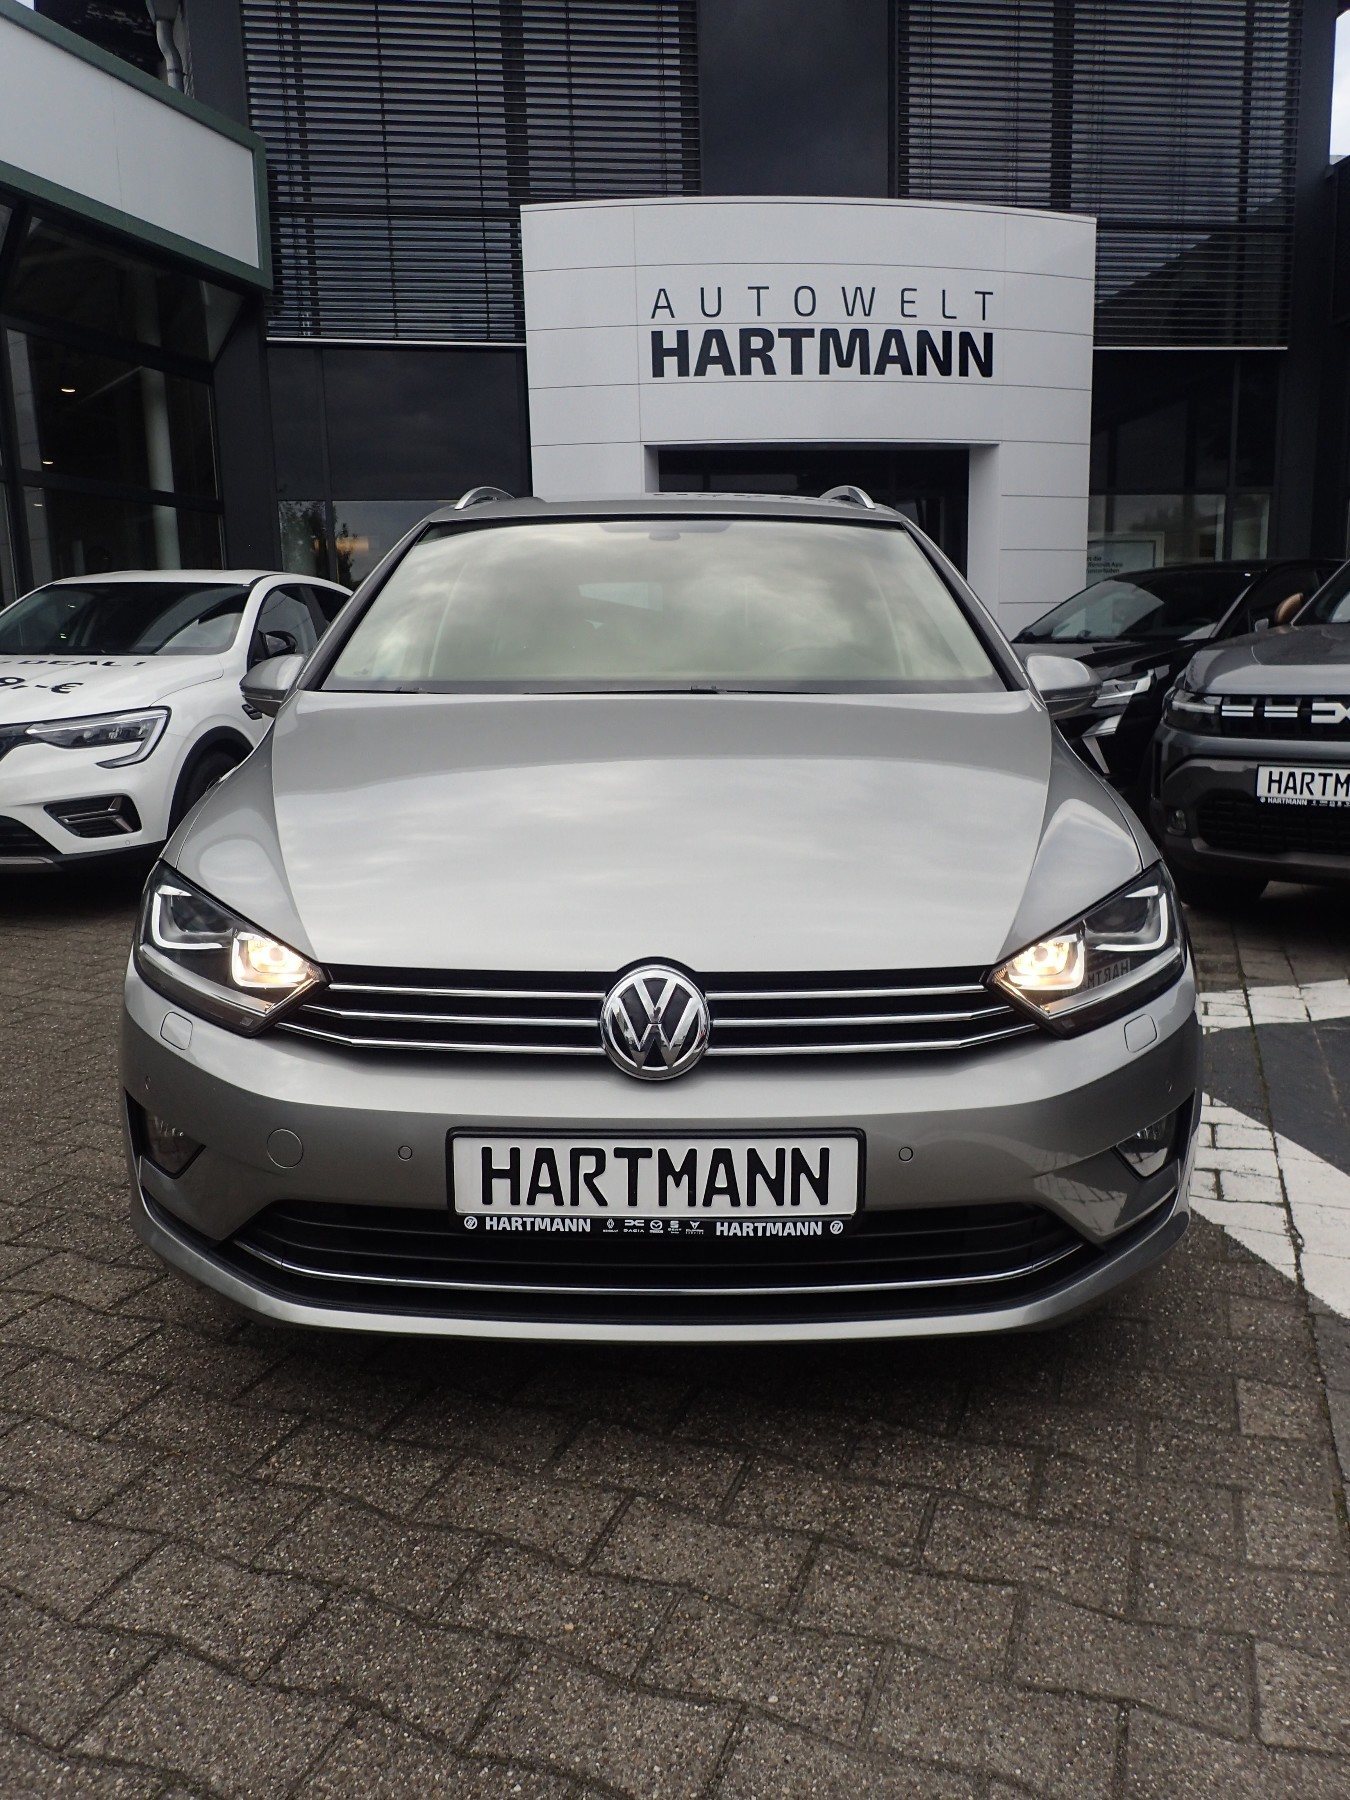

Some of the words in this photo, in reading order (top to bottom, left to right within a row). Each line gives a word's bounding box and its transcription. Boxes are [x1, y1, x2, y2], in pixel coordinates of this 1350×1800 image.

[651, 286, 994, 321] AUTOWELT
[651, 328, 994, 378] HARTMANN
[1268, 797, 1308, 806] HARTMANN
[481, 1146, 830, 1207] HARTMANN
[485, 1216, 591, 1232] HARTMANN
[715, 1220, 823, 1237] HARTMANN
